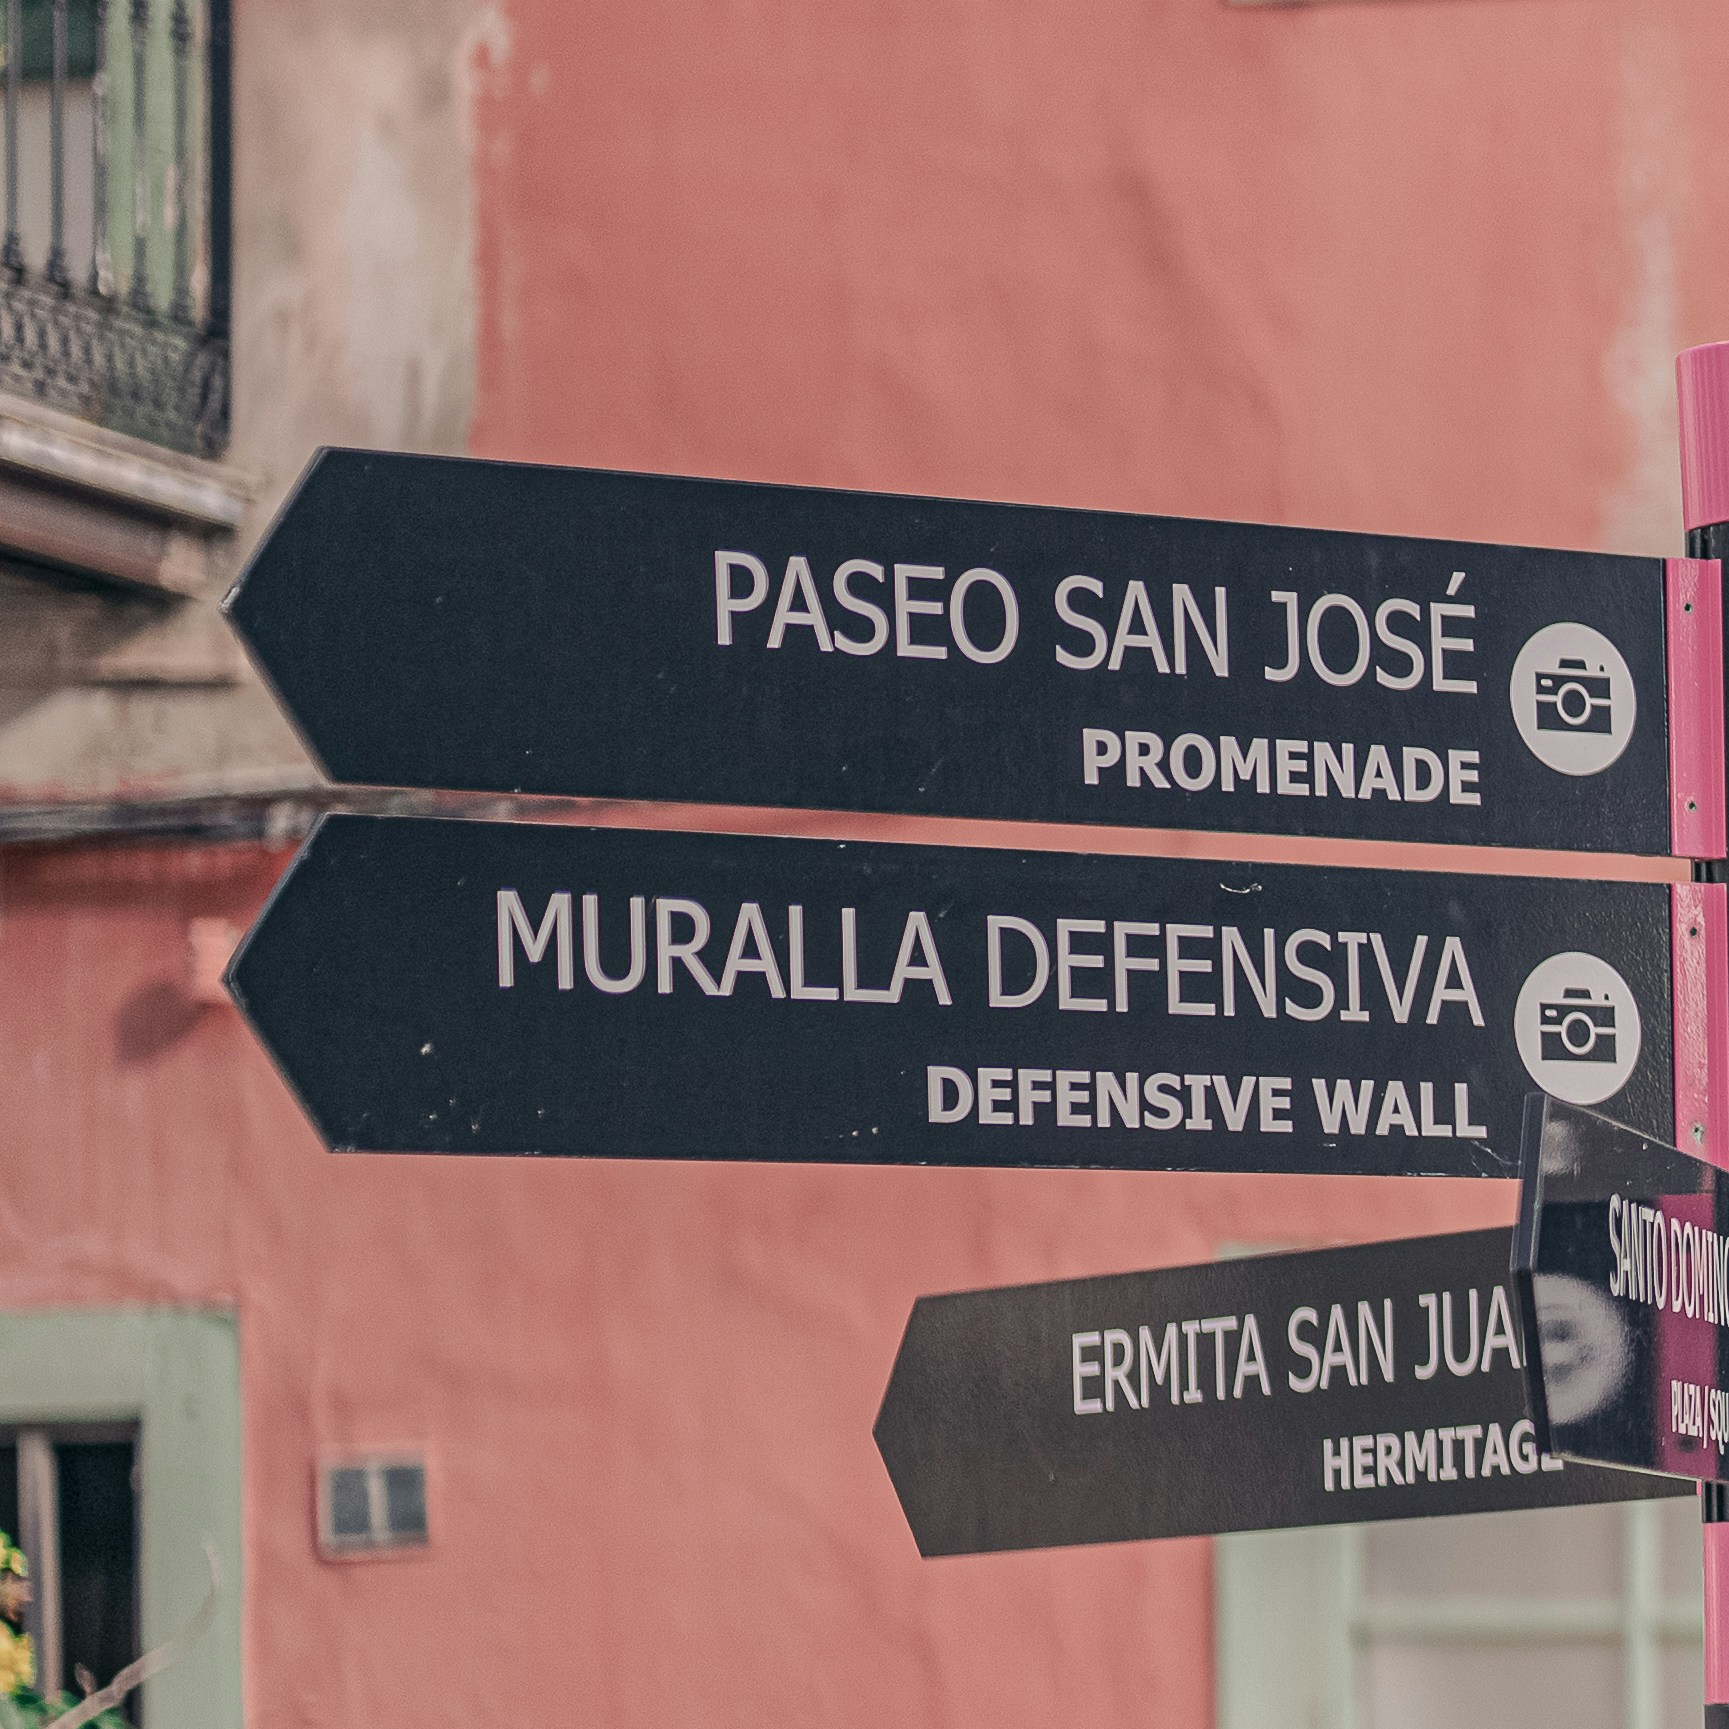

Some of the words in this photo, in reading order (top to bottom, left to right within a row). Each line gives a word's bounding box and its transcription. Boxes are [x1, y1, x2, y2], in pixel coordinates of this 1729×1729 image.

[715, 551, 1019, 664] PASEO
[1055, 575, 1228, 677] SAN
[1265, 572, 1477, 693] JOSÉ
[1083, 728, 1481, 805] PROMENADE
[497, 890, 952, 1005] MURALLA
[987, 915, 1485, 1026] DEFENSIVA
[928, 1066, 1293, 1132] DEFENSIVE
[1312, 1079, 1487, 1138] WALL
[1609, 1193, 1666, 1310] SANTO
[1072, 1314, 1270, 1414] ERMITA
[1288, 1299, 1394, 1392] SAN
[1414, 1285, 1527, 1381] JUA
[1324, 1418, 1564, 1491] HERMITAG
[1671, 1379, 1703, 1438] PLAZA
